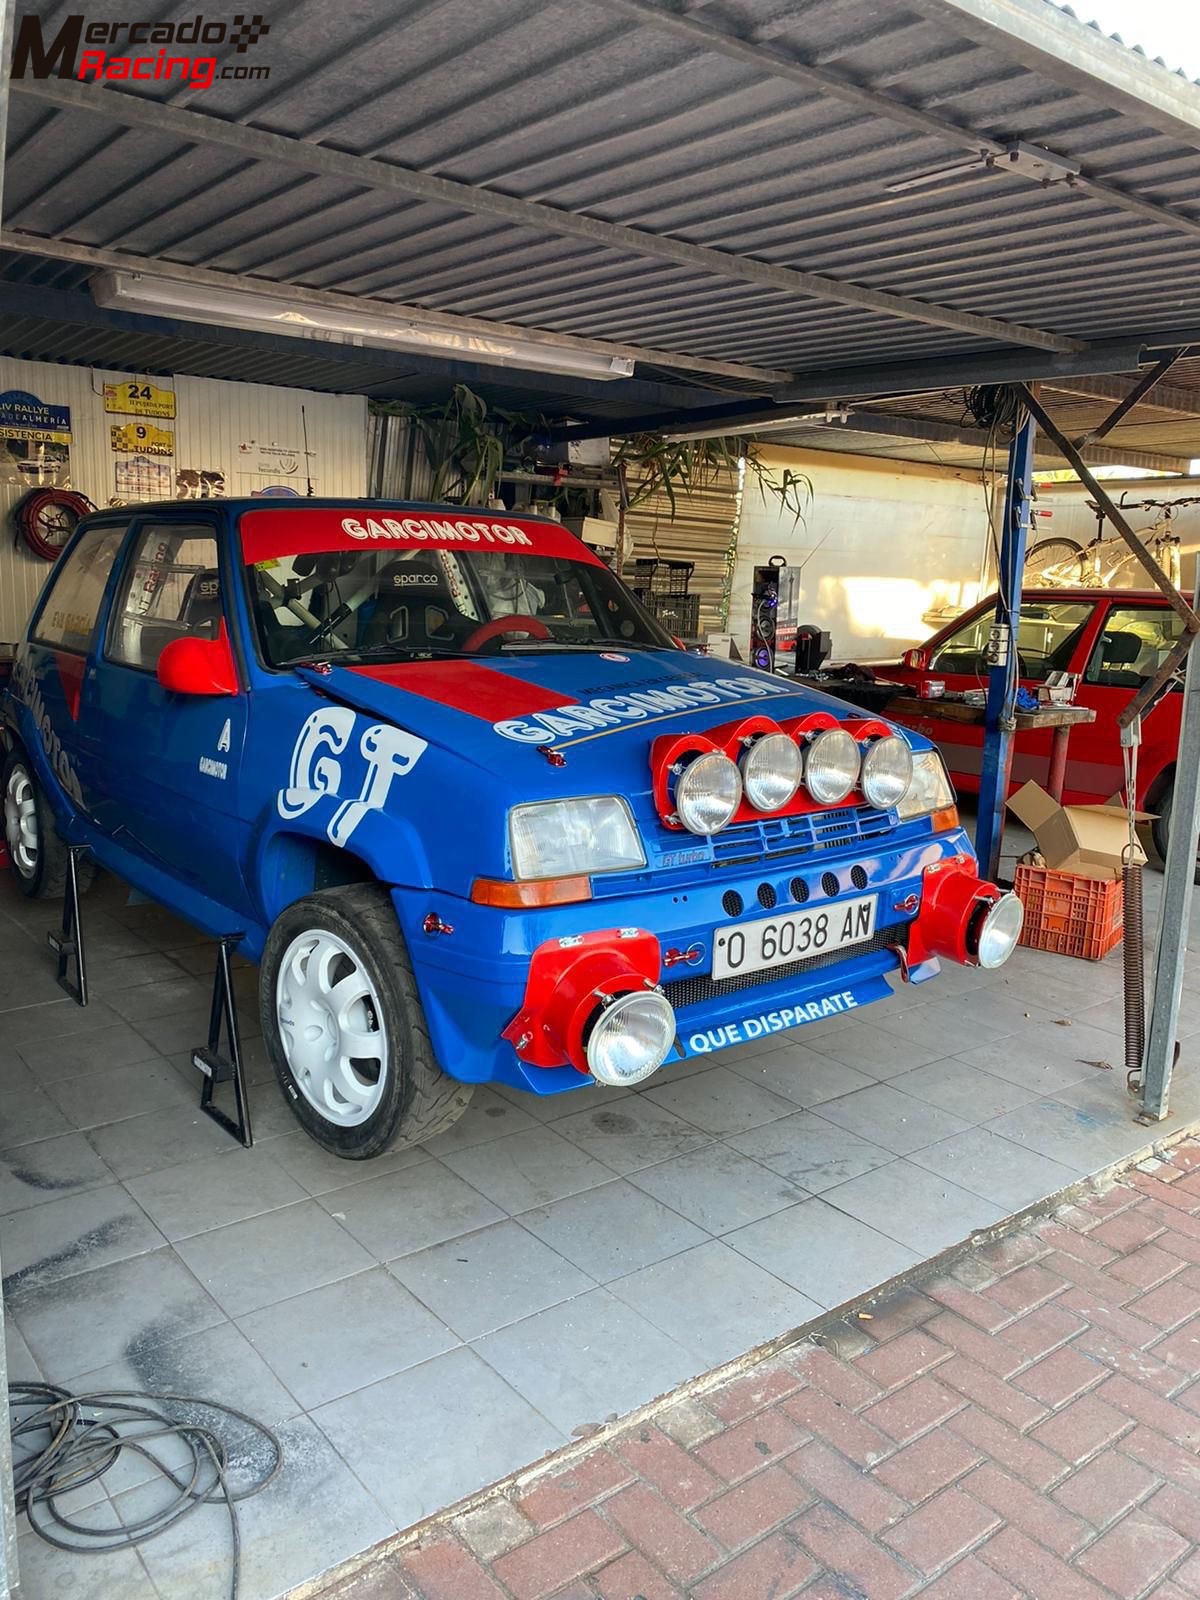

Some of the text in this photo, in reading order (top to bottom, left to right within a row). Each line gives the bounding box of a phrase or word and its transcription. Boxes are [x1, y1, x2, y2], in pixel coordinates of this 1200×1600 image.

[128, 385, 152, 400] 24
[15, 404, 49, 415] RALLYE
[136, 426, 147, 439] 9
[341, 518, 533, 546] GARCIMOTOR
[393, 573, 439, 586] sparco
[493, 677, 790, 744] GARCIMOTOR
[217, 718, 231, 752] A
[278, 706, 429, 848] GT
[761, 913, 829, 960] 6038
[840, 902, 872, 942] AN
[689, 991, 858, 1053] QUE DISPARATE
